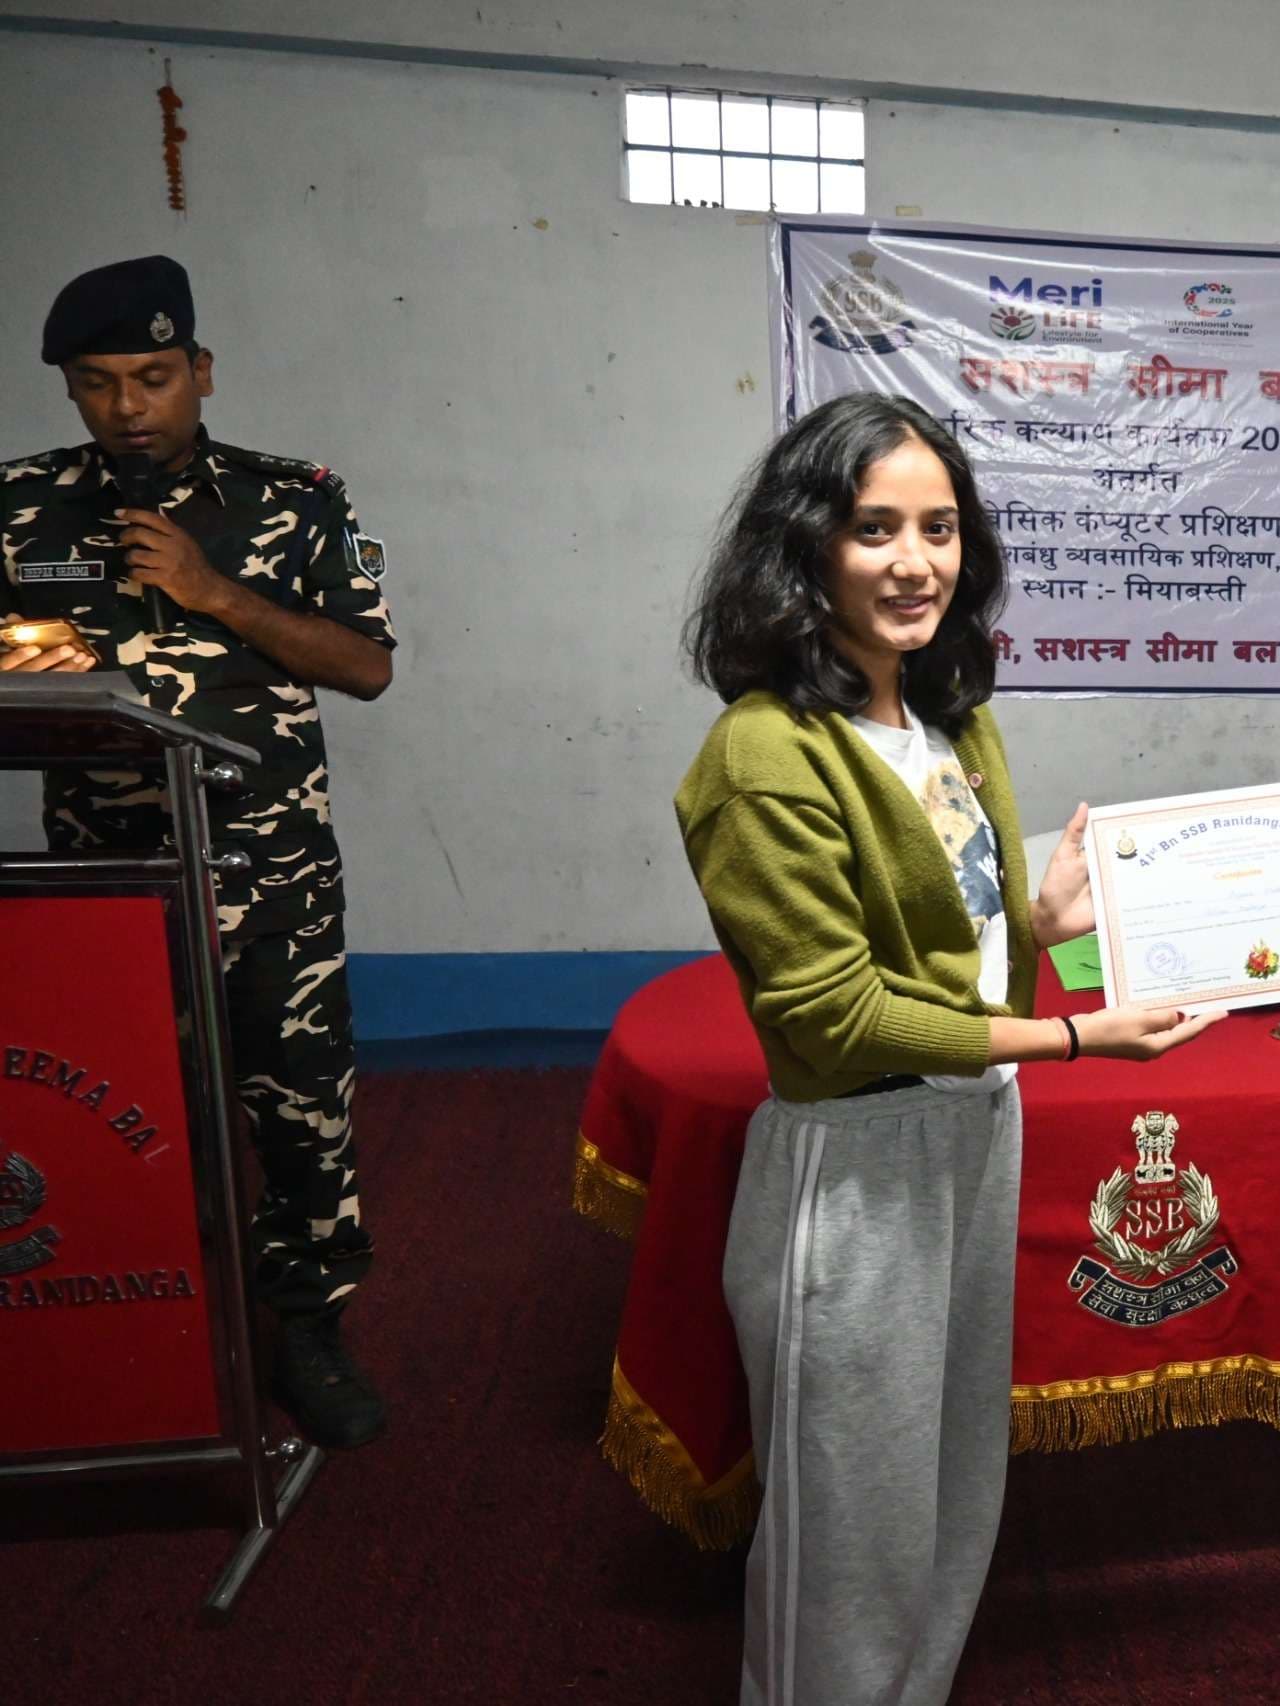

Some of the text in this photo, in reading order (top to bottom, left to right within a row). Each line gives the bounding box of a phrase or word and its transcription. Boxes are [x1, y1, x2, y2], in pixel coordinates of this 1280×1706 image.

[988, 275, 1103, 308] Meri
[1207, 296, 1236, 305] 2025
[1183, 327, 1249, 338] Cooperatives
[1232, 322, 1253, 330] Year
[1126, 354, 1229, 400] सीमा
[1076, 505, 1171, 543] कंप्यूटर
[1066, 543, 1184, 567] व्यवसायिक
[1022, 578, 1088, 599] स्थान
[1124, 576, 1247, 601] मियाबस्ती
[1034, 637, 1130, 662] सशस्त्र
[1146, 631, 1218, 663] सीमा
[1233, 640, 1280, 664] बल
[1159, 837, 1179, 852] Bn
[1180, 822, 1208, 840] SSB
[3, 1045, 111, 1112] EEMA
[1126, 1197, 1185, 1240] SSB
